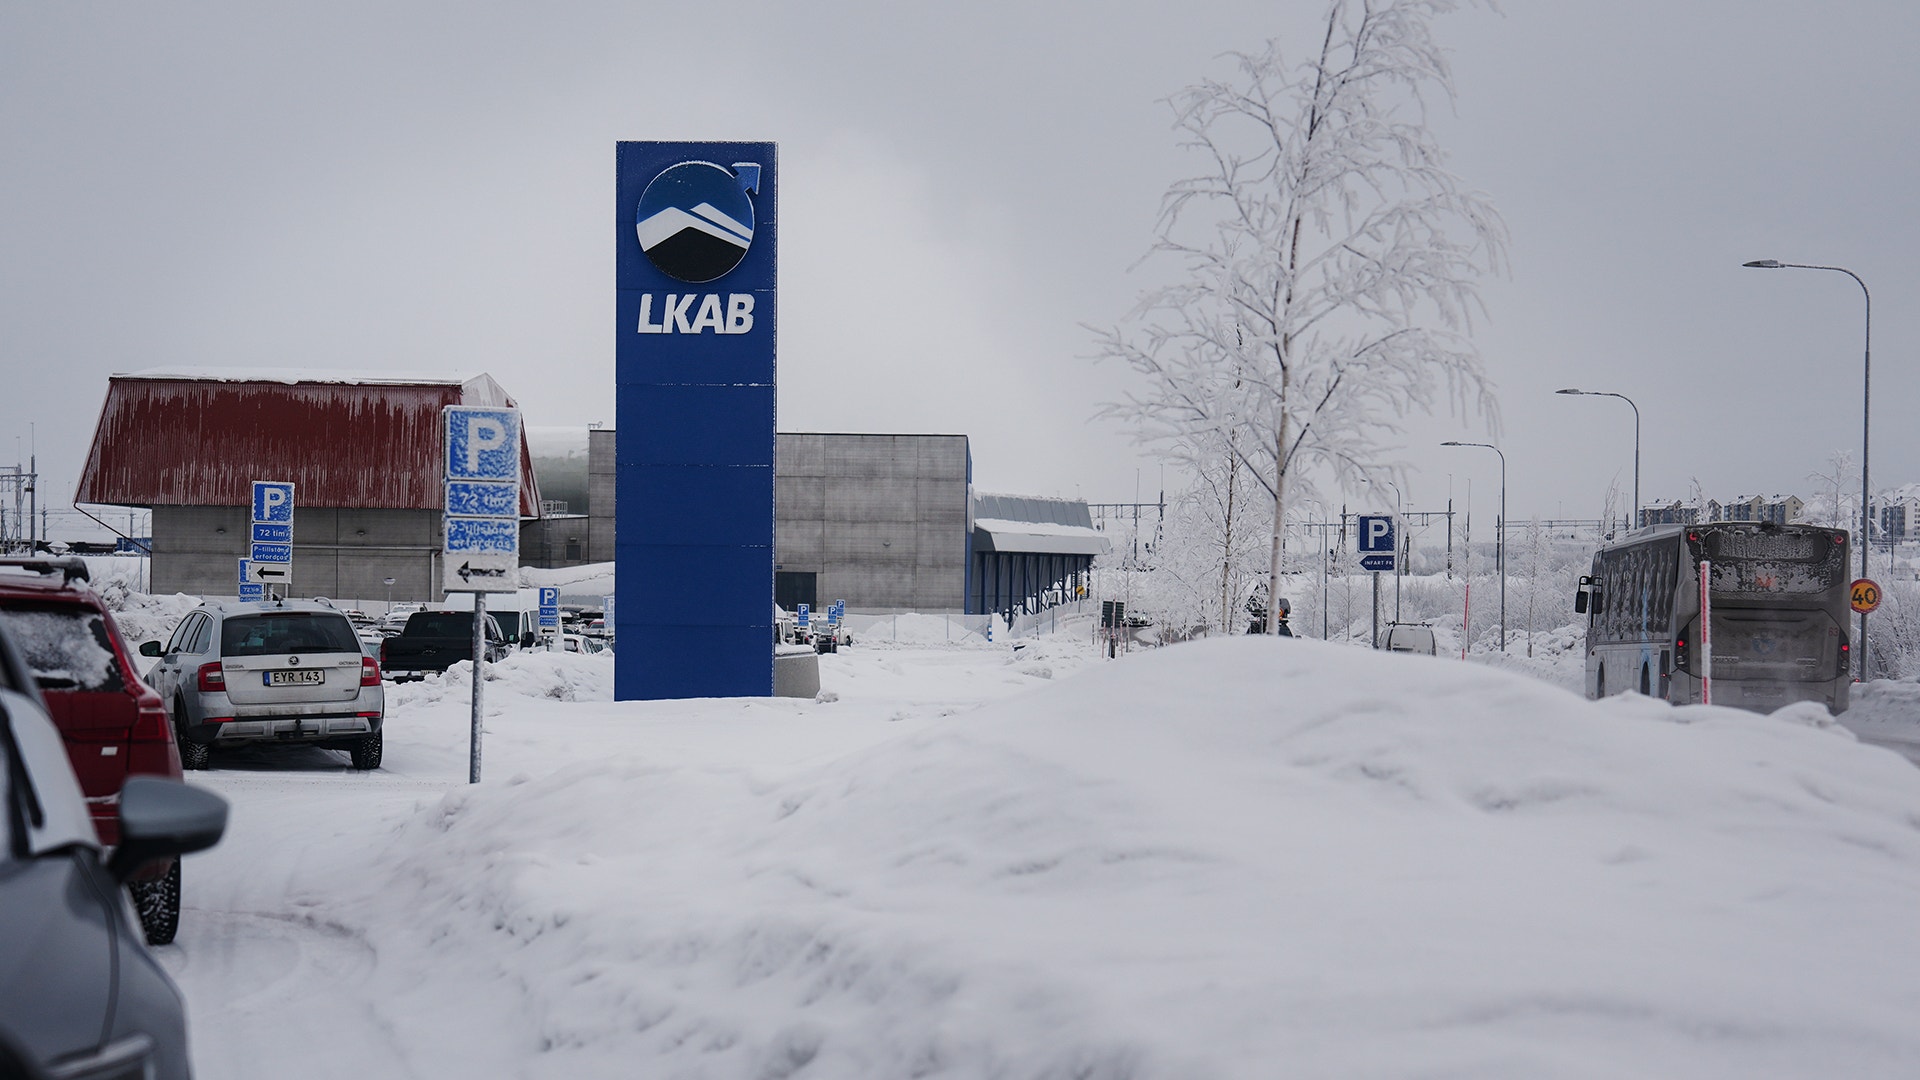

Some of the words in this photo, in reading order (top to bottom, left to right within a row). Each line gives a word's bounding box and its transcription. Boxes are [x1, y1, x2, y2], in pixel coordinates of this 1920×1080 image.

[637, 293, 755, 334] LKAB
[467, 417, 506, 472] P
[264, 487, 286, 518] P
[460, 493, 478, 507] 72
[259, 529, 270, 537] 72
[272, 529, 285, 537] tim
[1368, 519, 1389, 548] P
[543, 589, 555, 605] P
[1852, 587, 1877, 605] 40
[800, 606, 806, 614] P
[273, 672, 296, 682] EYR
[299, 671, 320, 682] 143
